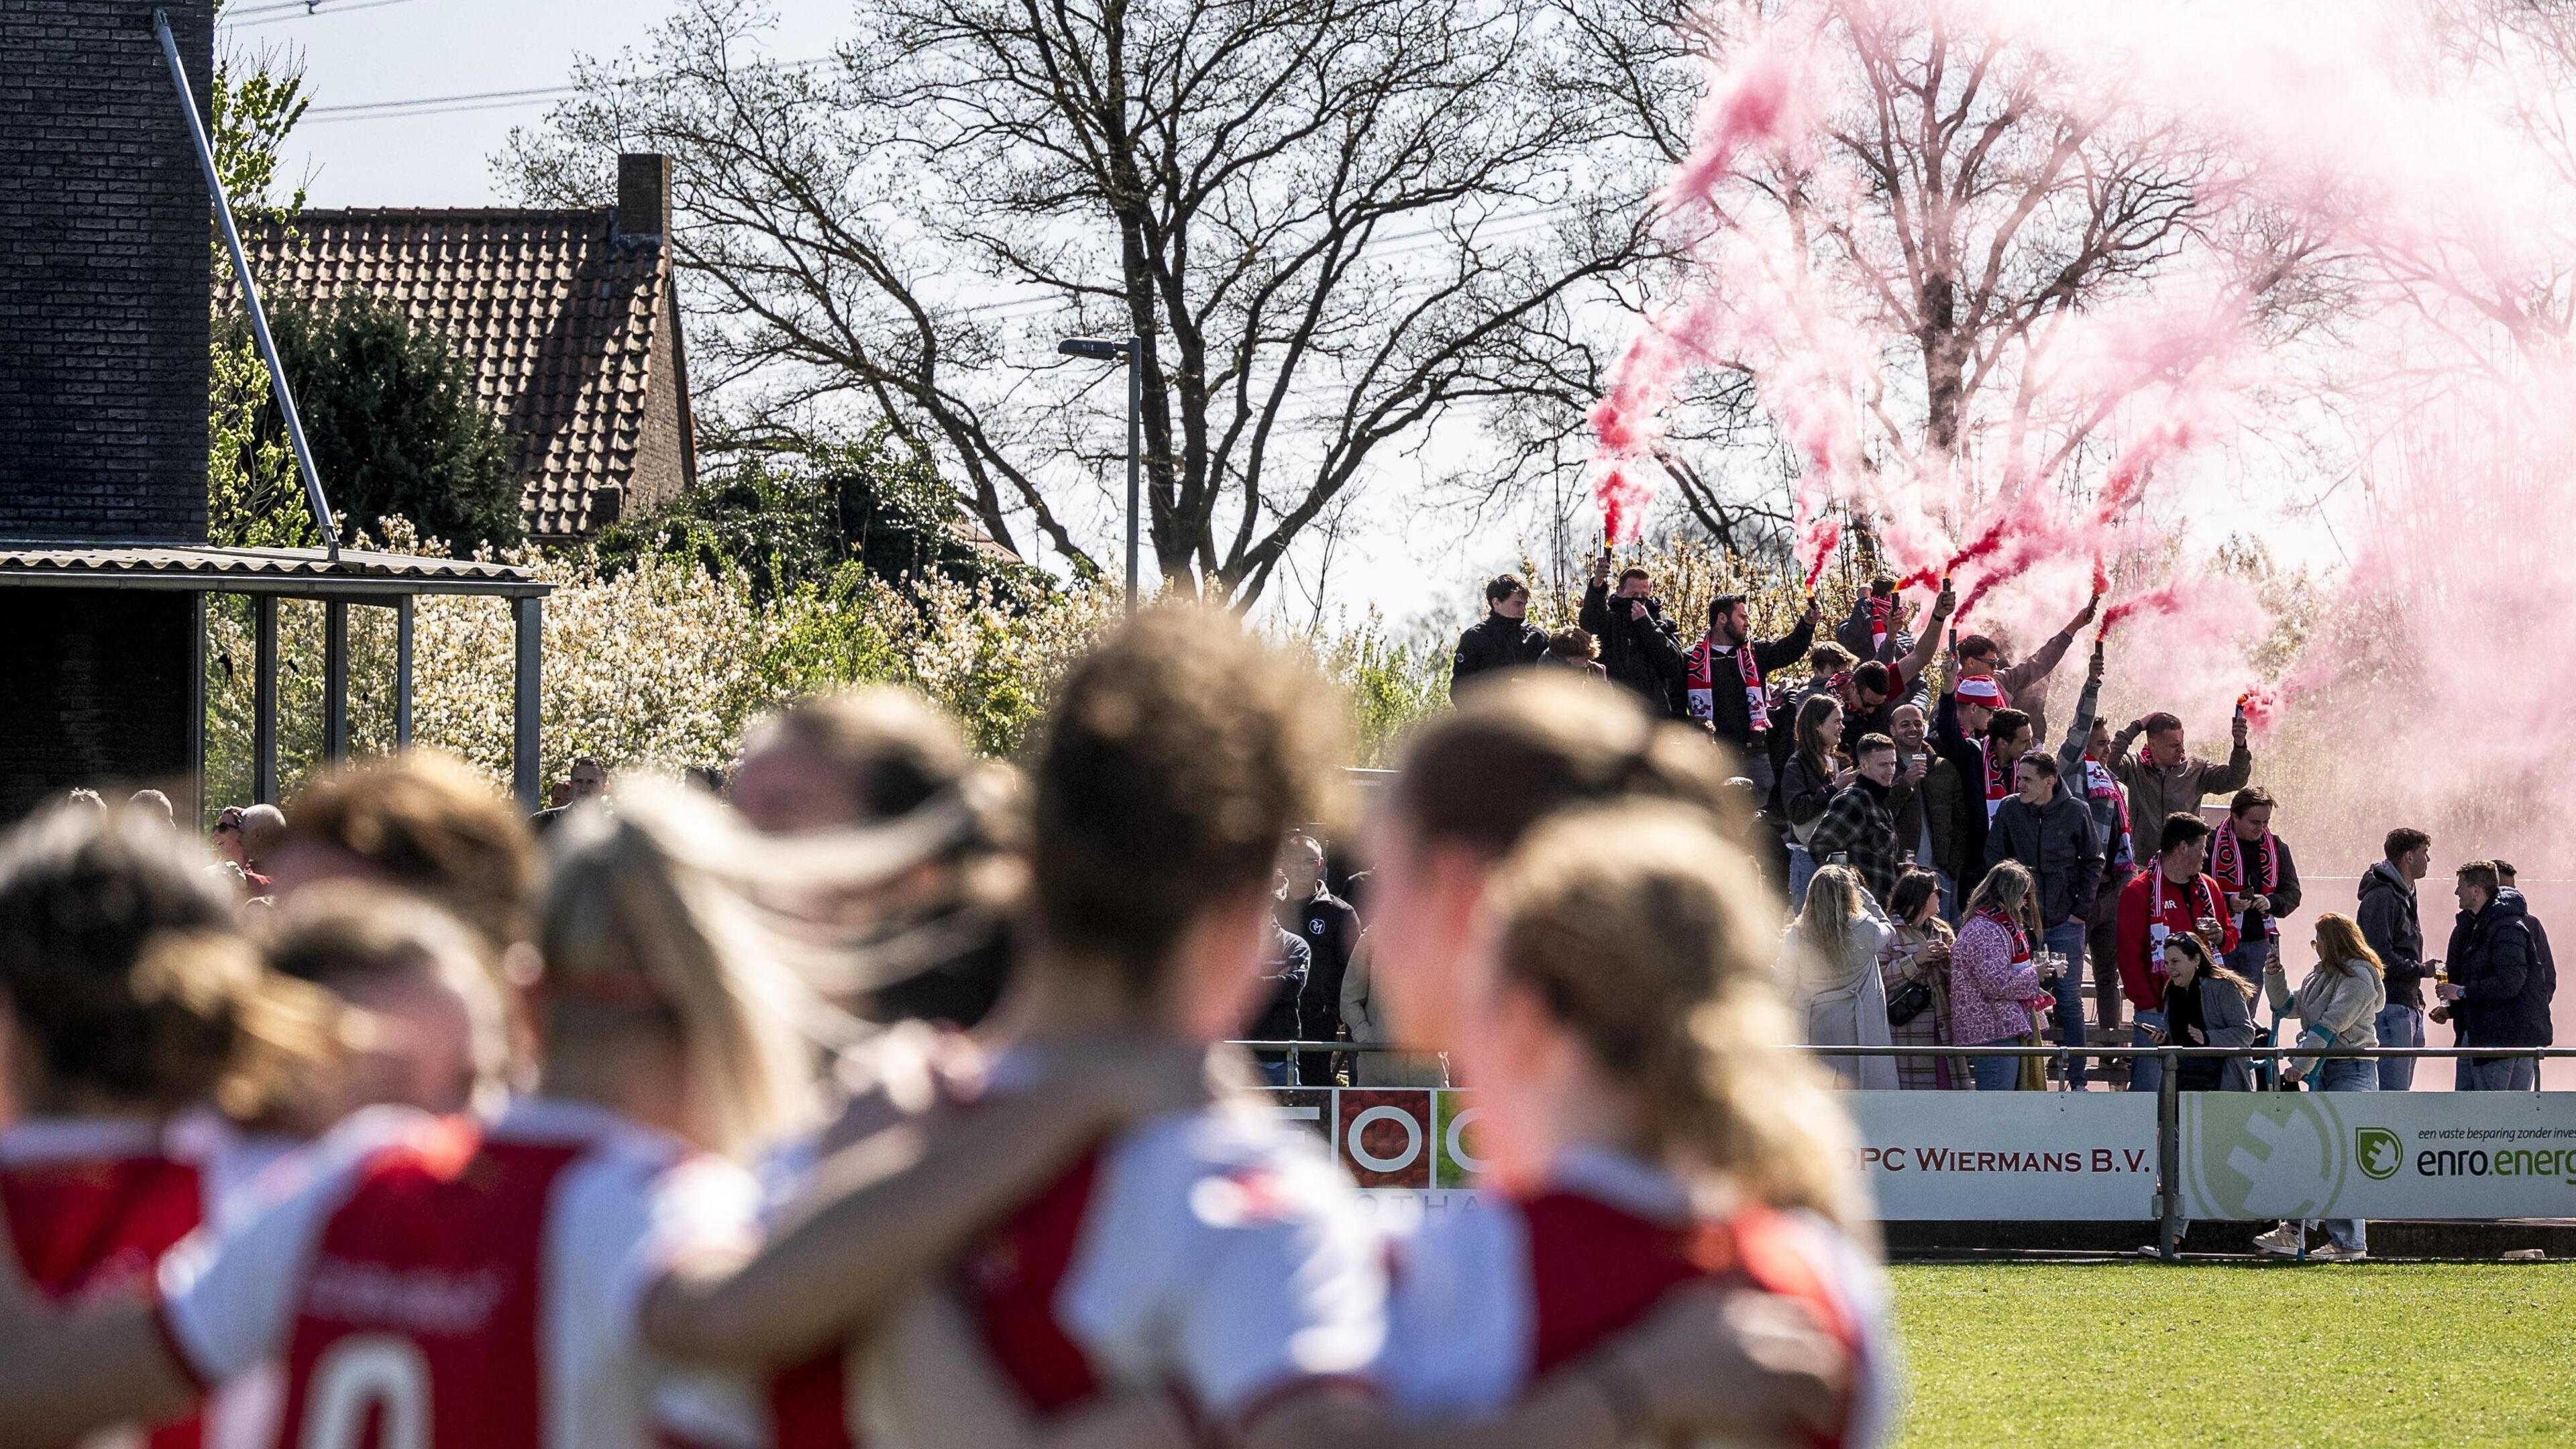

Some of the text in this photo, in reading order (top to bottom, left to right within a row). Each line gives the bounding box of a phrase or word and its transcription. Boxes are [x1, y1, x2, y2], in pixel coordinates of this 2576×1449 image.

[2418, 1129, 2436, 1139] een
[2439, 1128, 2465, 1139] vaste
[2467, 1127, 2516, 1142] besparing
[2517, 1128, 2551, 1139] zonder
[2091, 1149, 2150, 1173] B.V.
